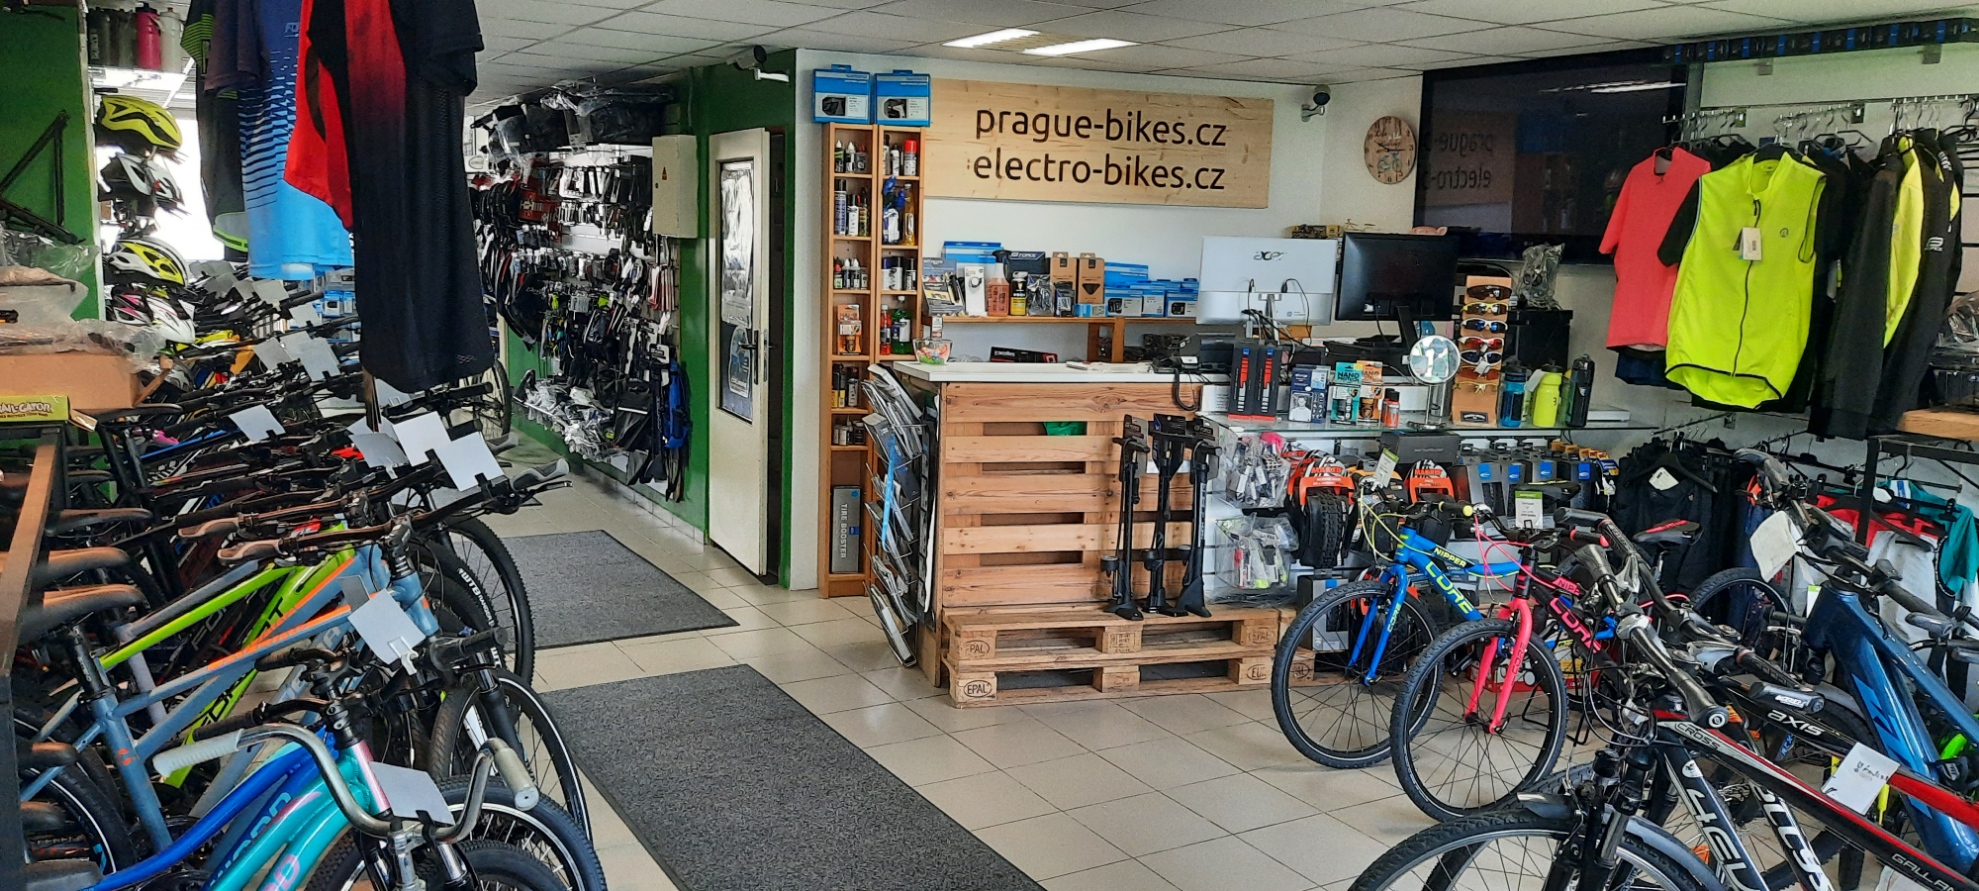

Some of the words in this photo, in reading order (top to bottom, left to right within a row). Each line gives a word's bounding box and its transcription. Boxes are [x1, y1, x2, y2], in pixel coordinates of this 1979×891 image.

[975, 108, 1227, 146] prague-bikes.cz
[973, 147, 1226, 190] electro-bikes.cz
[1337, 371, 1360, 379] NANO
[840, 503, 848, 521] TIRE
[840, 523, 848, 558] BOOSTER
[1433, 547, 1467, 567] NIPPER
[460, 572, 482, 596] WTB
[1425, 561, 1474, 614] CORE
[490, 646, 503, 669] WT
[967, 684, 987, 695] EPAL
[1676, 723, 1721, 750] CROSS
